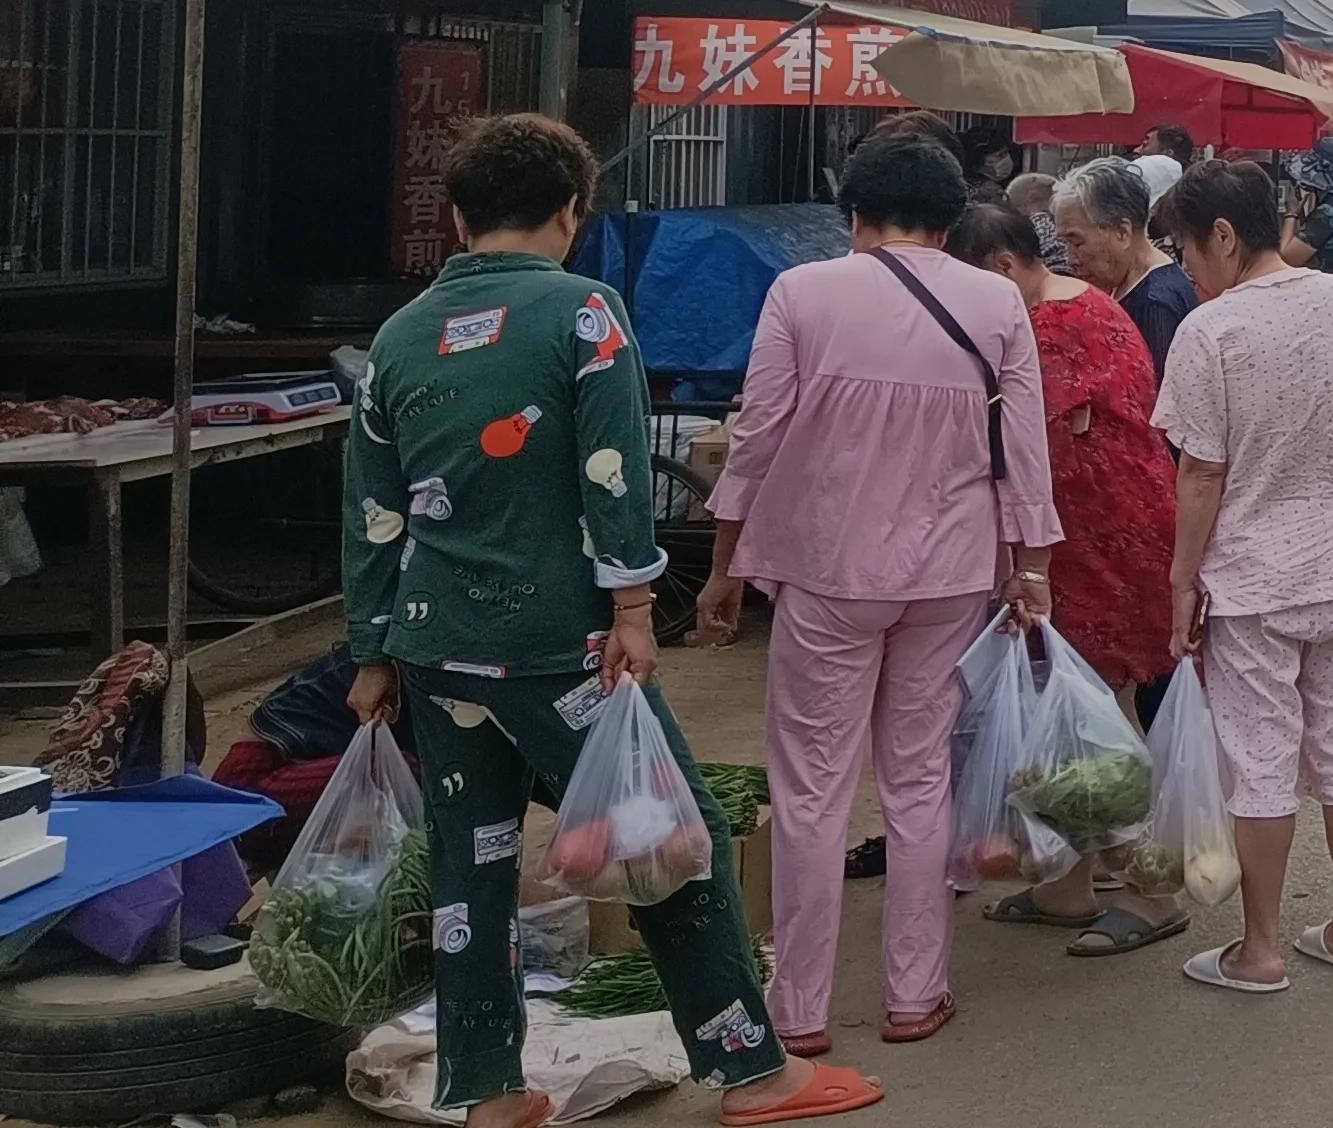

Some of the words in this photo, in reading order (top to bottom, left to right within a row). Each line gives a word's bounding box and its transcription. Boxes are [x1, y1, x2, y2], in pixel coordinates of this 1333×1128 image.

[634, 24, 904, 98] 九妹香煎
[403, 66, 450, 276] 九妹香煎
